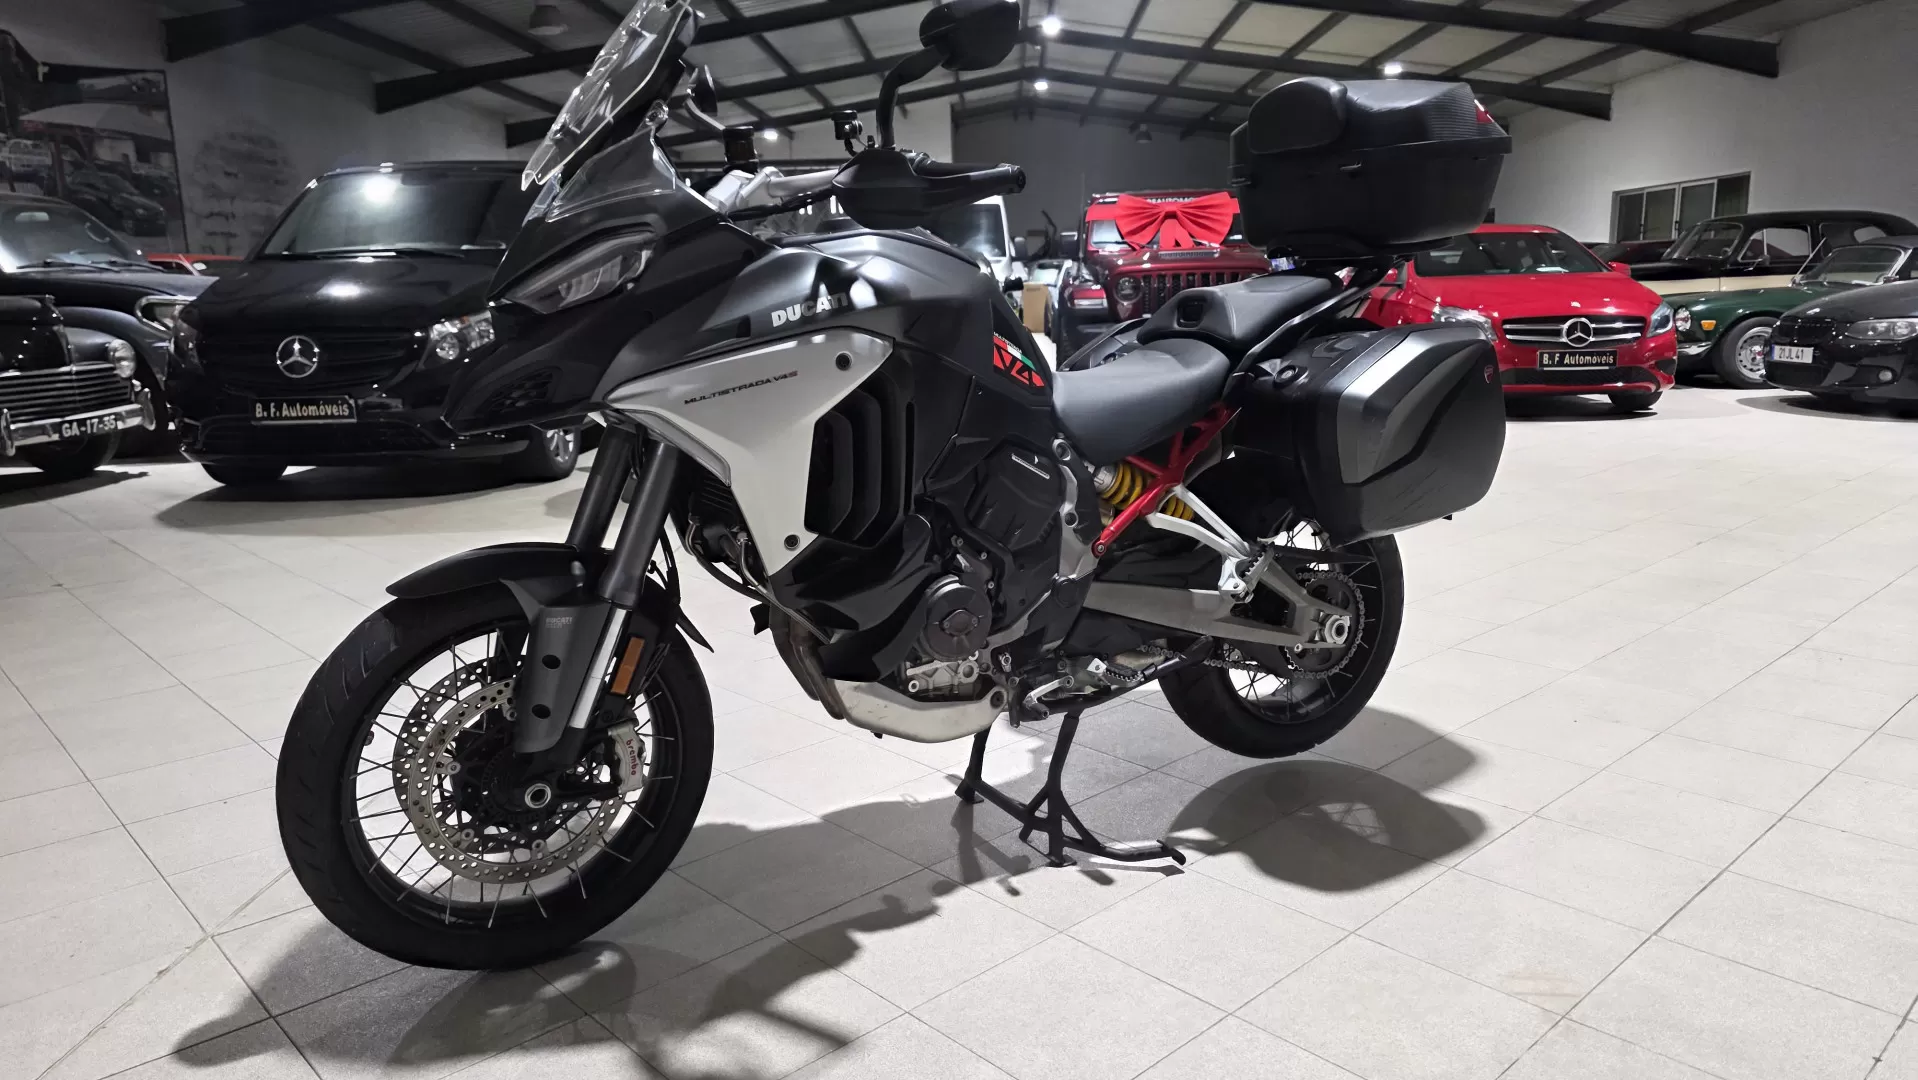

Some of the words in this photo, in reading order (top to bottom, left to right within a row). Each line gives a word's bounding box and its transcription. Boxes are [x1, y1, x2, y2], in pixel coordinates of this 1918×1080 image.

[771, 292, 848, 327] DUCATI
[684, 378, 772, 405] MULTISTRADA
[773, 370, 798, 382] V4S
[255, 402, 268, 418] B.
[270, 402, 280, 417] F.
[282, 400, 350, 417] Automóveis
[625, 738, 639, 776] brembo
